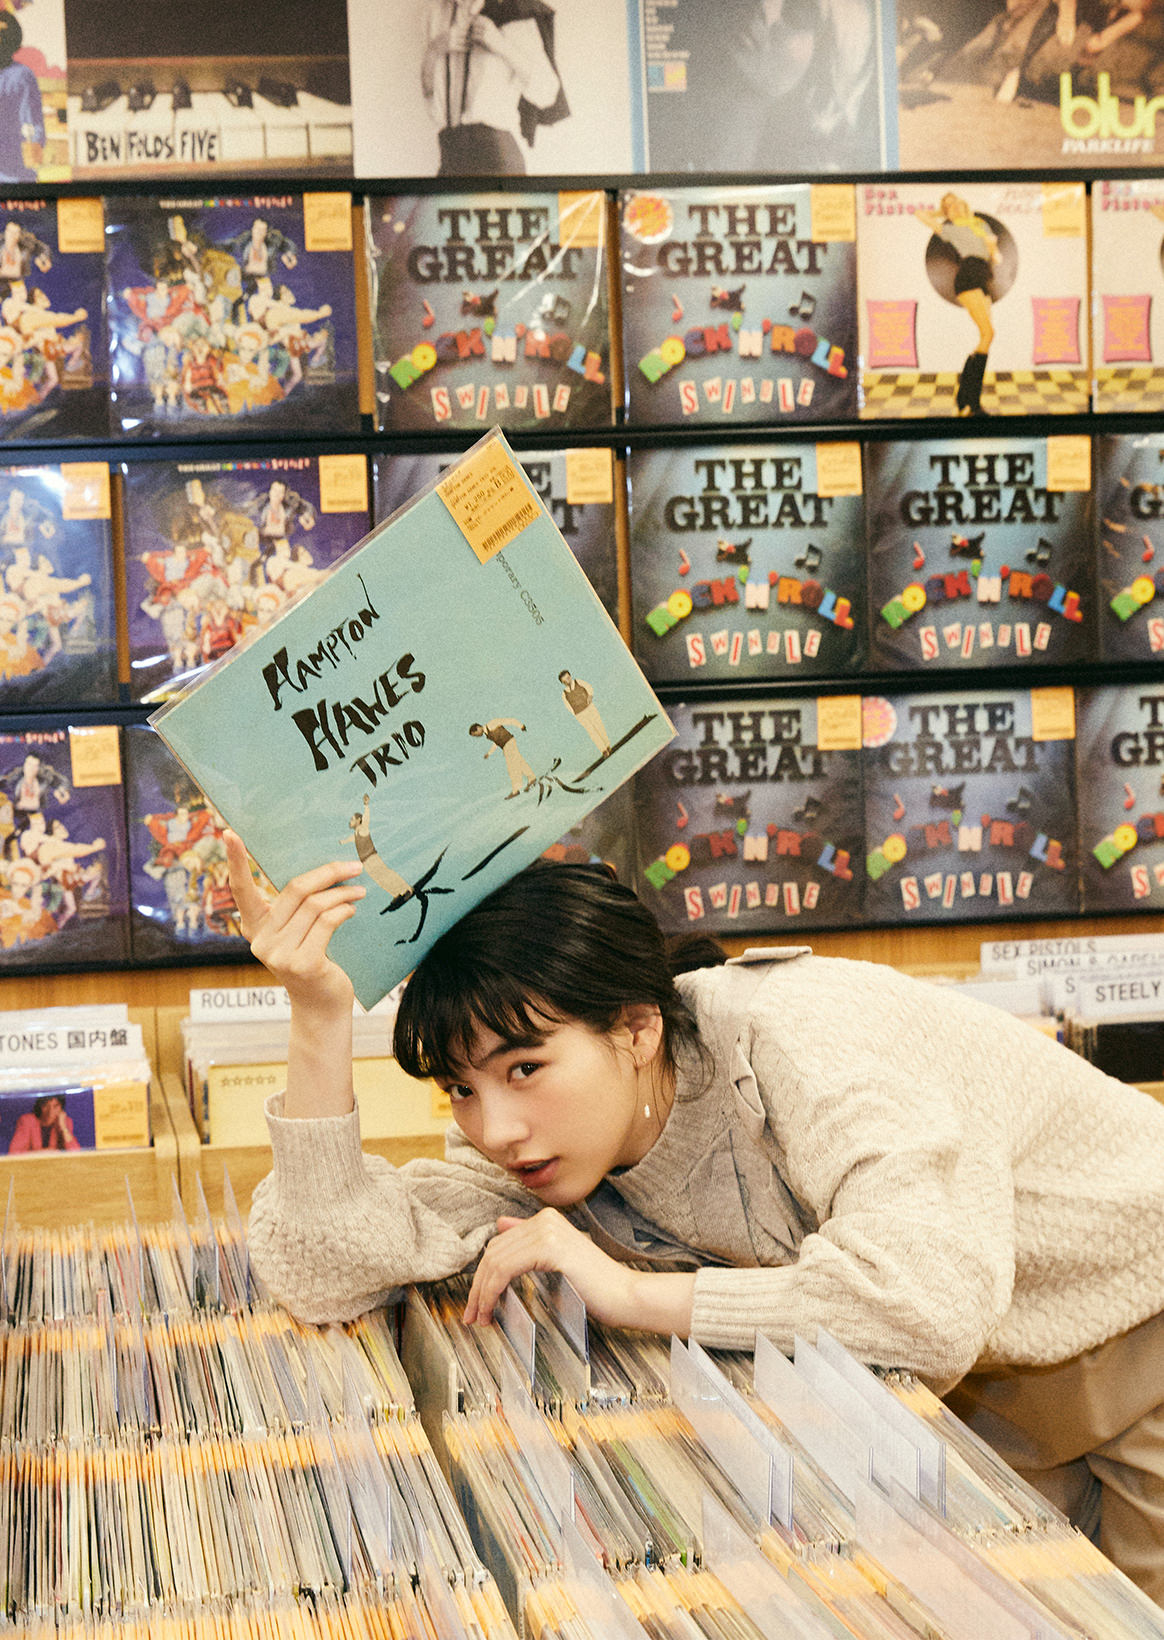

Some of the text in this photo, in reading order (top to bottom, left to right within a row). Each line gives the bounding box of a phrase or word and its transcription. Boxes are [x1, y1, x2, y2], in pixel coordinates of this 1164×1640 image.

[1060, 71, 1164, 139] blur
[86, 129, 217, 162] BEN FOLDS FIVE
[438, 207, 549, 242] THE
[689, 204, 796, 238] THE
[408, 245, 583, 283] GREAT
[657, 240, 828, 277] GREAT
[431, 383, 571, 422] SWINDLE
[679, 376, 815, 415] SWINDLE
[694, 457, 802, 492] THE
[930, 453, 1034, 487] THE
[664, 493, 834, 532] GREAT
[900, 487, 1066, 526] GREAT
[496, 551, 521, 589] porary
[262, 573, 380, 711] HAMPTON
[686, 629, 822, 668] SWINDLE
[919, 622, 1052, 661] SWINDLE
[291, 652, 426, 771] HAWES
[692, 709, 802, 746] THE
[909, 701, 1015, 737] THE
[349, 720, 426, 788] TRIO
[666, 745, 833, 786] GREAT
[888, 737, 1046, 778] GREAT
[684, 881, 821, 921] SWINDLE
[900, 871, 1034, 911] SWINDLE
[992, 945, 1021, 961] SEX
[201, 990, 276, 1009] ROLLING
[1095, 981, 1161, 1003] STEELY
[67, 1028, 128, 1049] 国内盤
